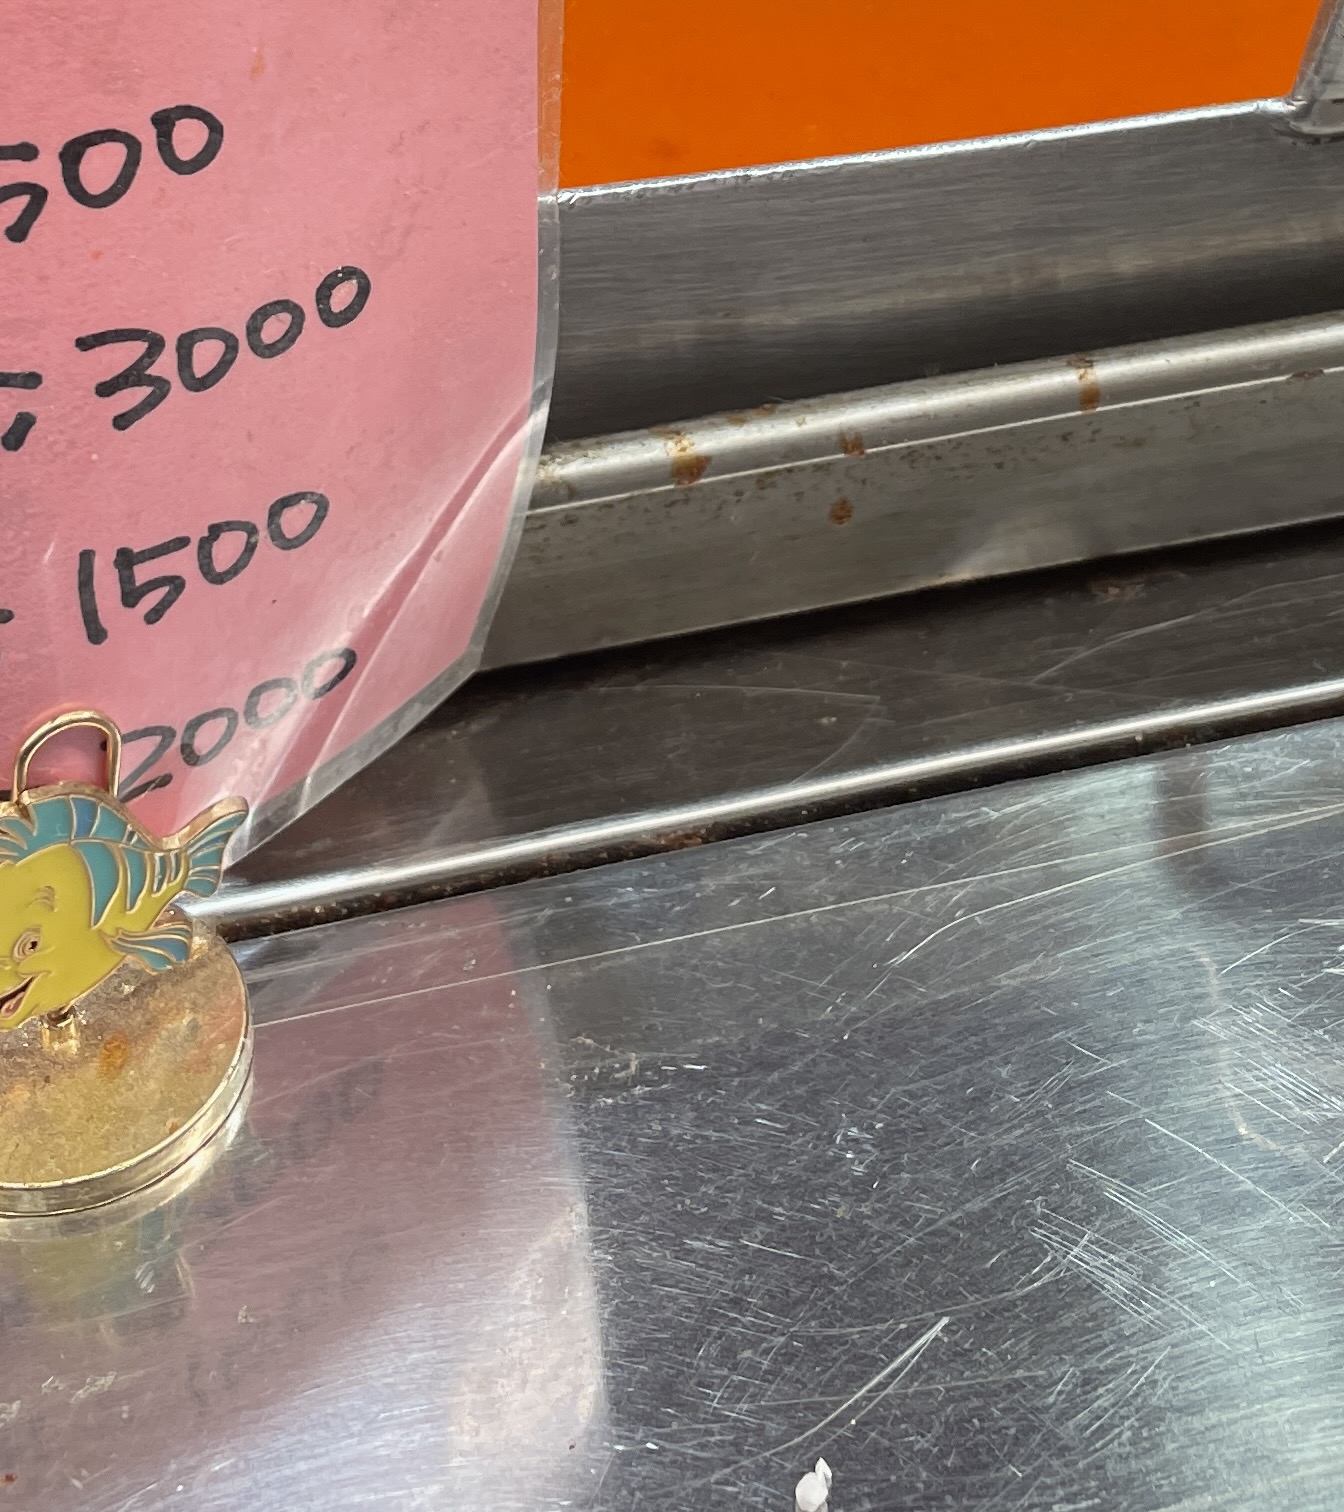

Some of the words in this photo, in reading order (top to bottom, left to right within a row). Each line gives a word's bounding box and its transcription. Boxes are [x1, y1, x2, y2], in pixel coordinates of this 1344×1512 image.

[74, 264, 372, 431] 3000
[76, 489, 334, 646] 1500
[100, 646, 358, 804] 2000
